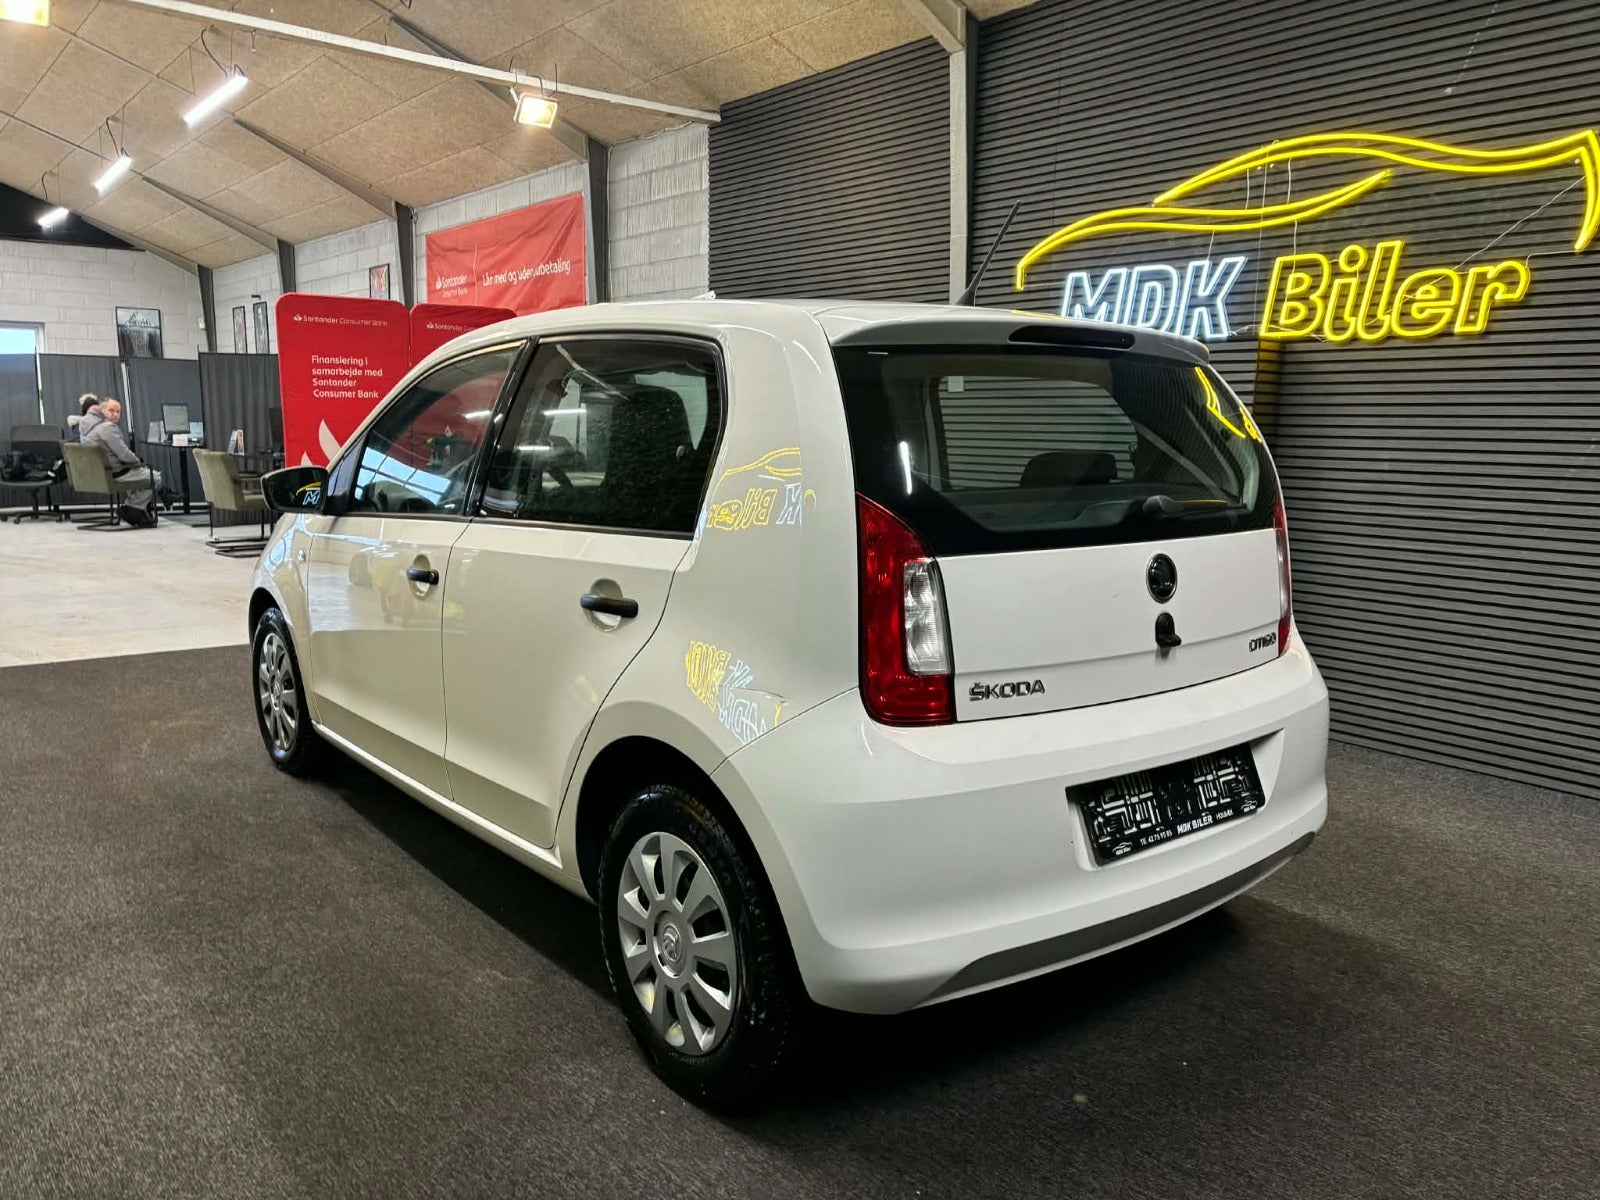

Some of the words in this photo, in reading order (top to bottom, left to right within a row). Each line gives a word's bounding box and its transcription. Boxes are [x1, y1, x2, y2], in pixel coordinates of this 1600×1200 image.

[508, 272, 518, 286] og
[1060, 255, 1247, 340] MDK
[1259, 240, 1531, 343] Biler
[303, 315, 338, 324] Santander
[339, 317, 372, 326] Consumer
[434, 323, 463, 332] Santander
[312, 355, 364, 367] Finansiering
[365, 356, 368, 365] i
[312, 367, 362, 377] samarbejde
[364, 369, 383, 377] med
[312, 378, 357, 387] Santander
[313, 389, 356, 398] Consumer
[357, 390, 379, 398] Bank
[968, 679, 1046, 702] ŠKODA
[1176, 822, 1191, 834] MDK
[1192, 814, 1213, 829] BILER
